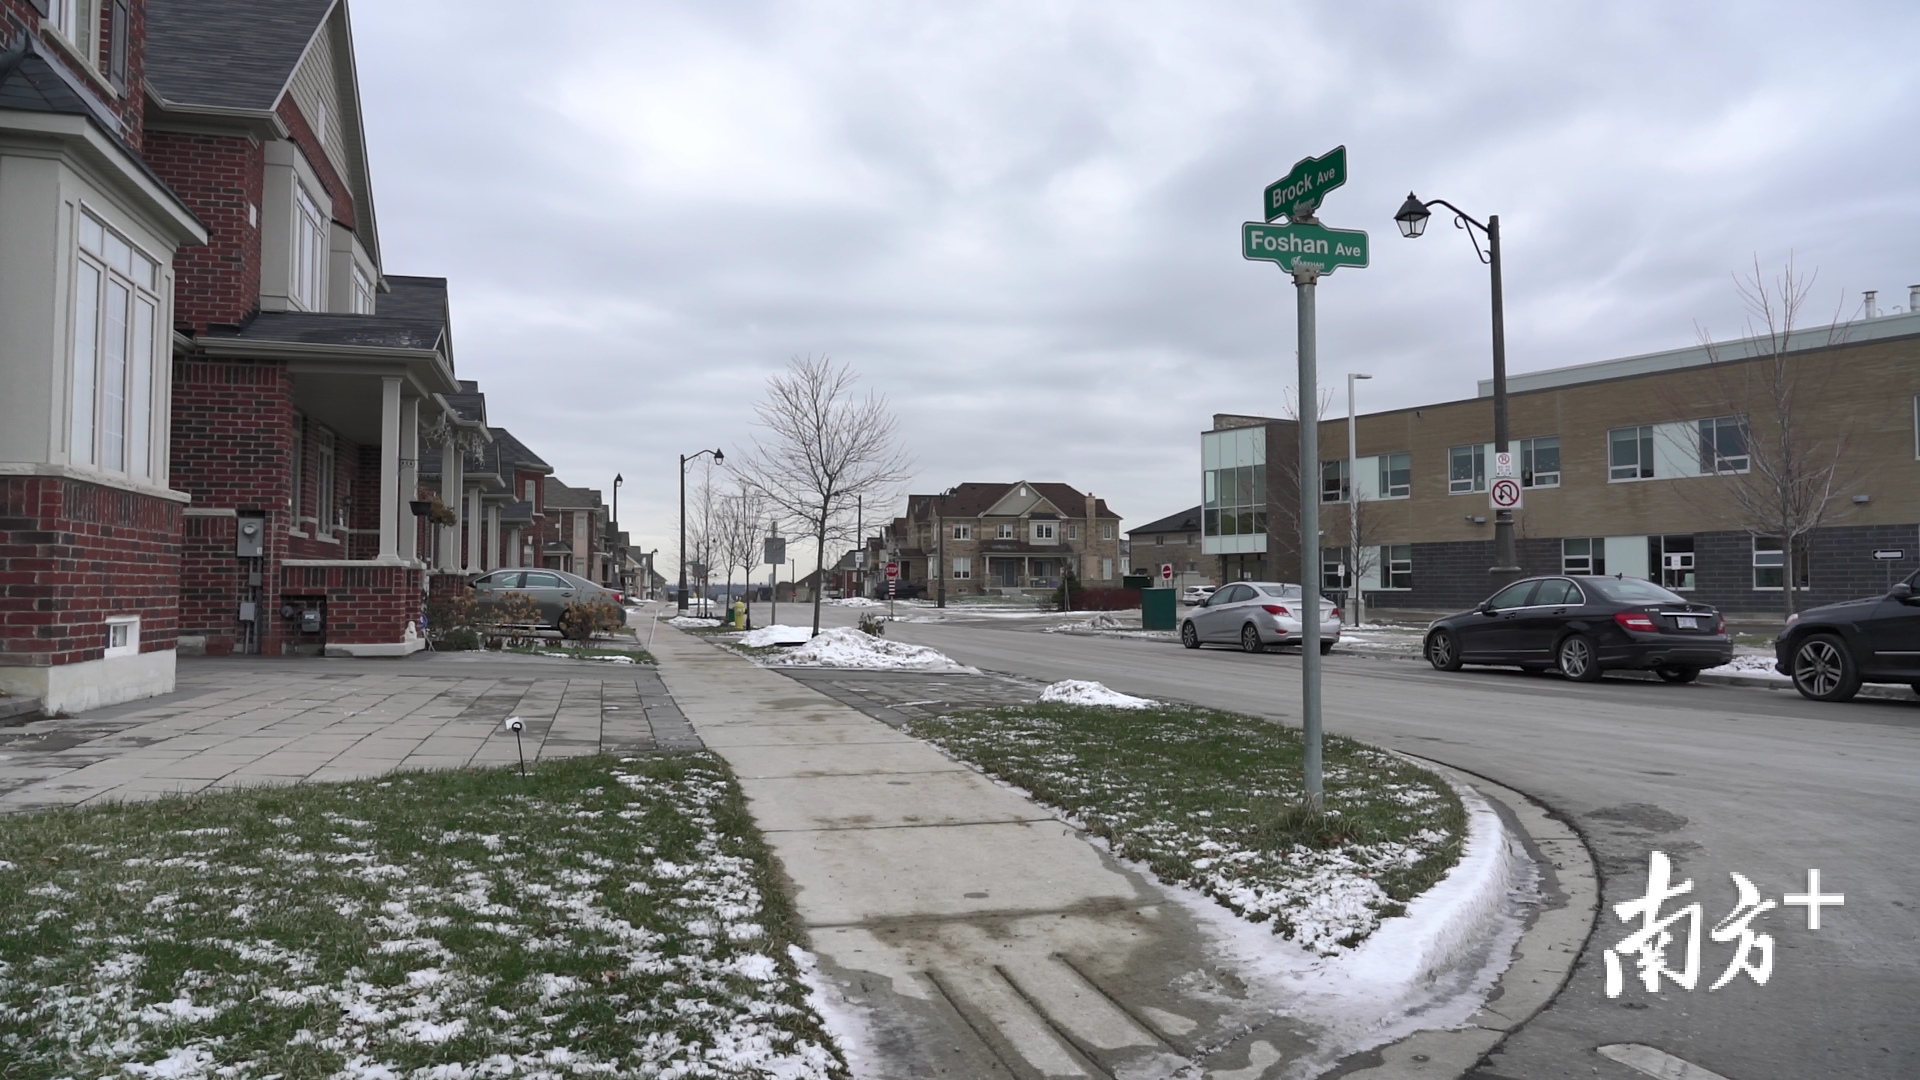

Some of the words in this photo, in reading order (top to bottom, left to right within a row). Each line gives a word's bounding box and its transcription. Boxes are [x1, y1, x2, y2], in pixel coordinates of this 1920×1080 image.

[1272, 173, 1313, 209] Brock
[1316, 167, 1336, 186] Ave
[1251, 230, 1329, 254] Foshan
[1335, 242, 1361, 257] Ave
